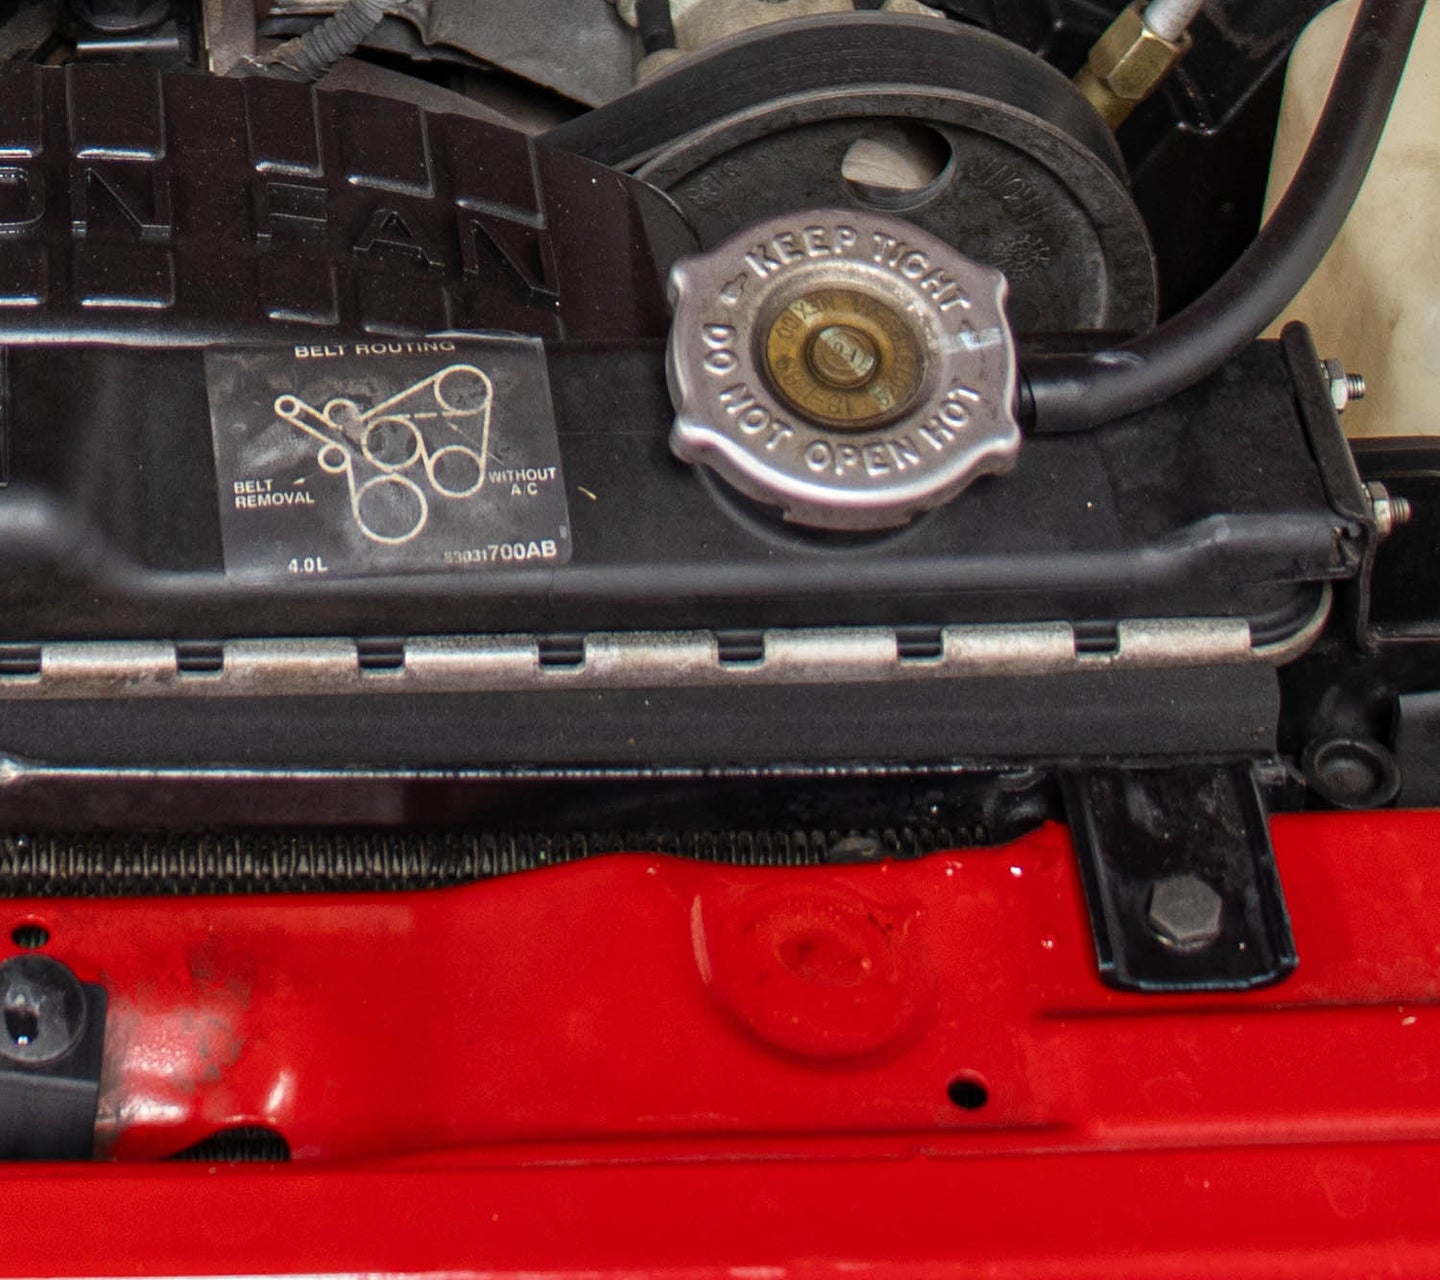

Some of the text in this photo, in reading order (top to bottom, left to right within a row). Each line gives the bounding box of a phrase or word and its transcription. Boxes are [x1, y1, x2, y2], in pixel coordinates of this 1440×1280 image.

[254, 179, 563, 310] FAN
[744, 224, 972, 312] KEEP TIGHT
[294, 341, 456, 359] BELT ROUTING
[701, 322, 981, 477] DO NOT OPEN HOT
[488, 467, 557, 484] WITHOUT
[233, 479, 274, 495] BELT
[234, 491, 316, 510] REMOVAL
[288, 557, 329, 573] 4.0L
